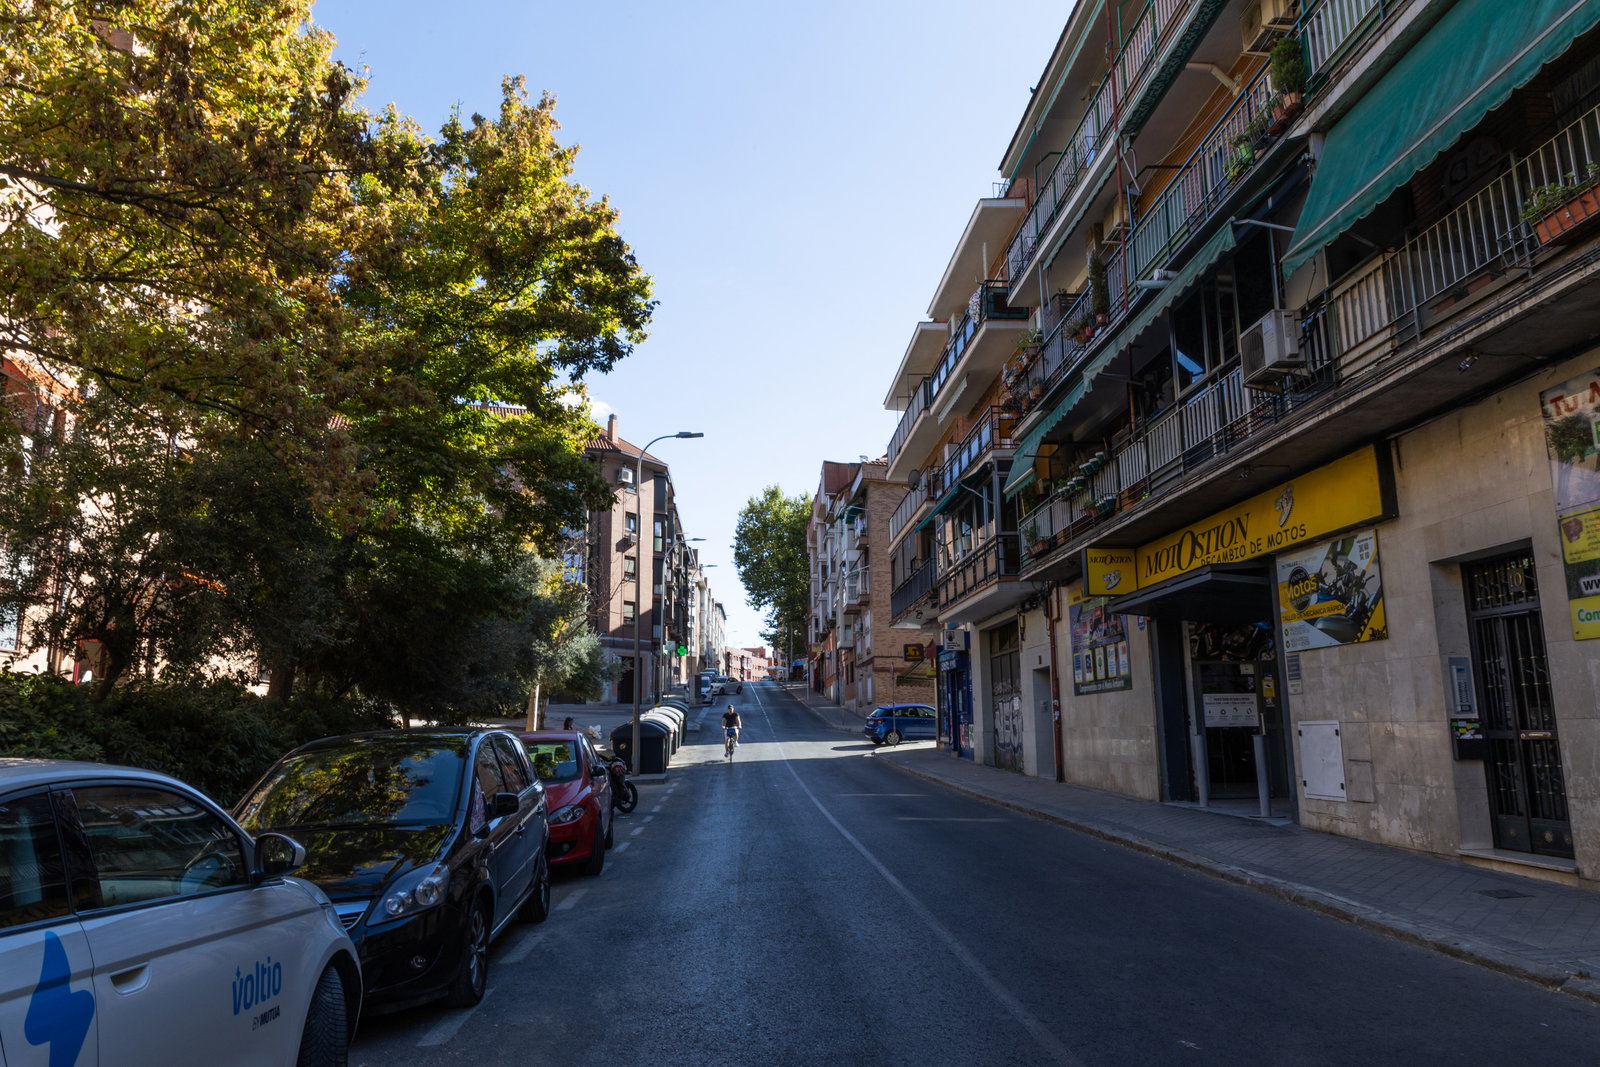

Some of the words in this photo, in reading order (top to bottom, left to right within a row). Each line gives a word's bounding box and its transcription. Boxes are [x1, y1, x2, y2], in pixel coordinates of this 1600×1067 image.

[1250, 537, 1262, 554] DE
[1267, 523, 1307, 548] MOTOS
[232, 956, 282, 1016] voltio
[259, 1005, 280, 1026] MUTUA
